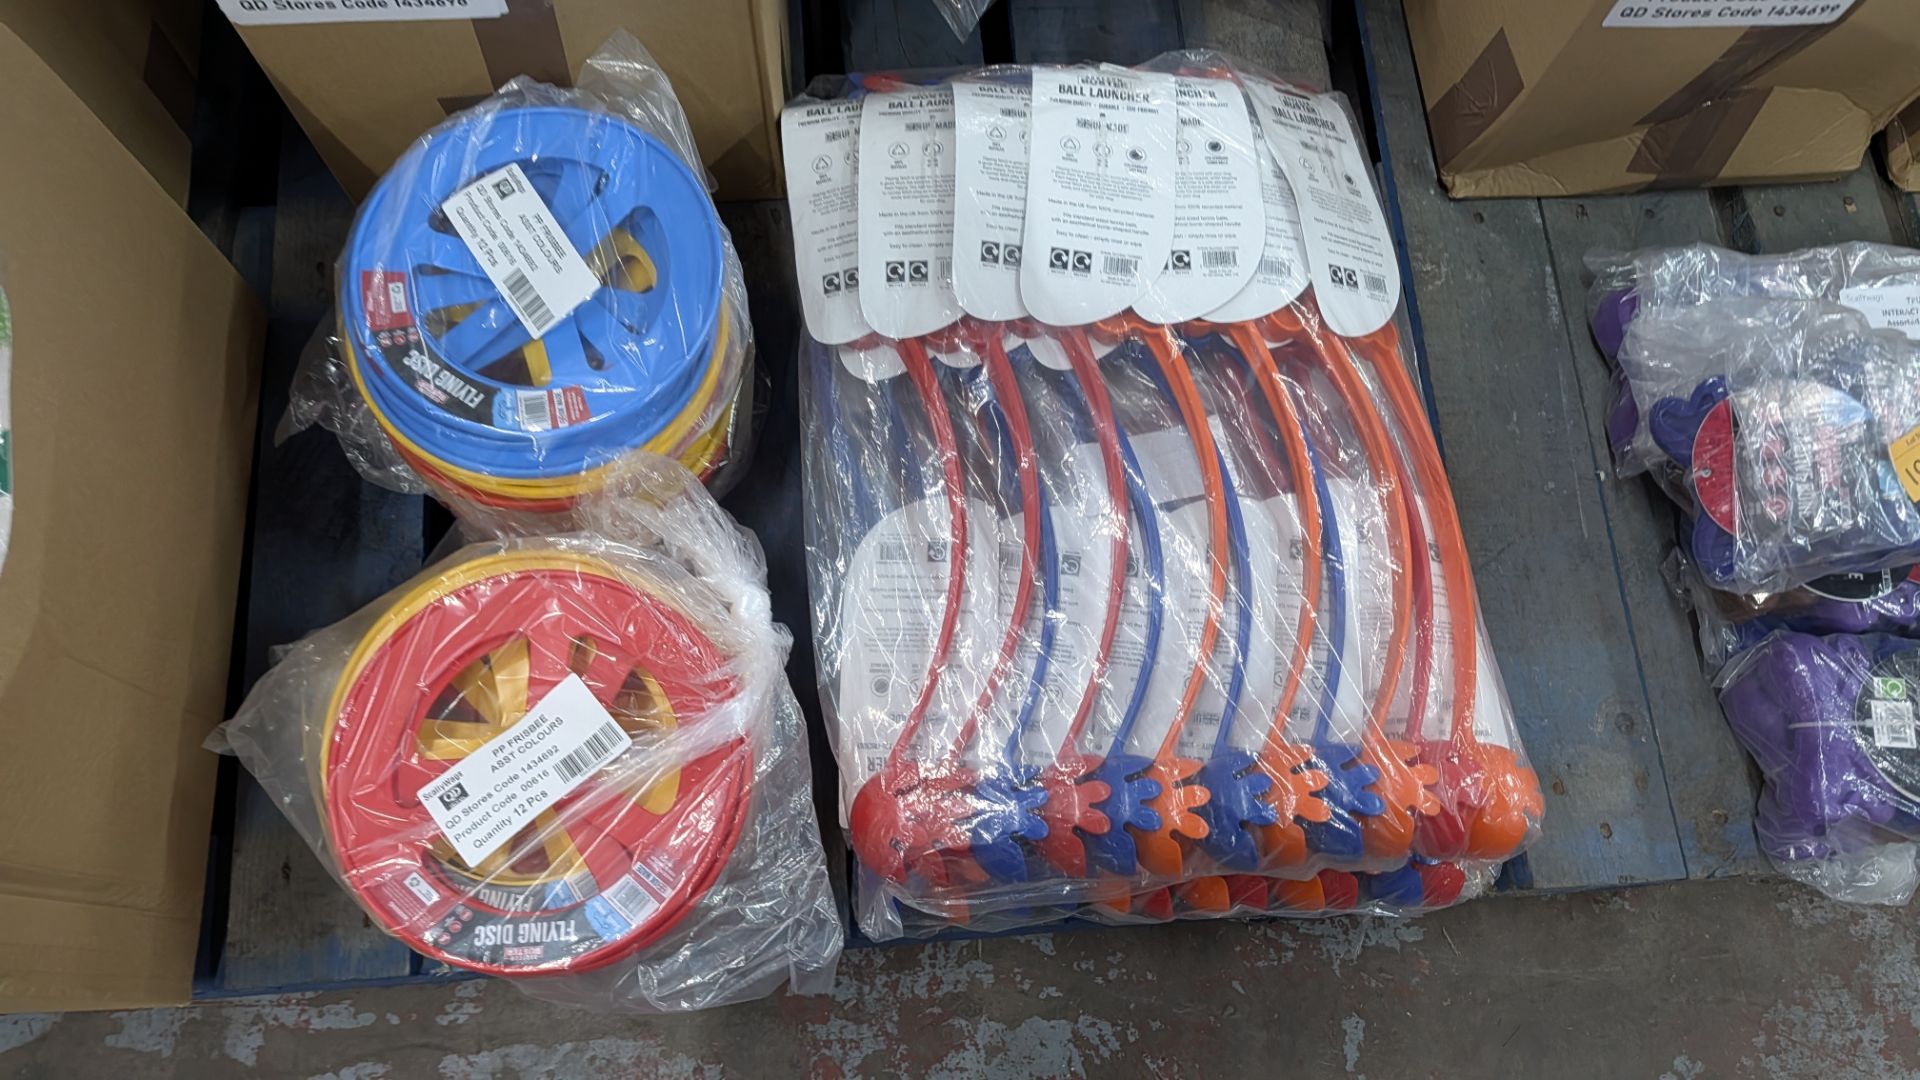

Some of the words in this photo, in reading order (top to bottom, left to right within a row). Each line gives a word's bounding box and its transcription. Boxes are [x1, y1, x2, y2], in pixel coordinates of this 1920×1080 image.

[1620, 7, 1648, 18] QD
[1652, 7, 1712, 18] Stores
[1718, 6, 1762, 17] Code
[1058, 84, 1086, 96] BALL
[1089, 86, 1150, 103] LAUNCHER
[807, 107, 832, 116] BALL
[1272, 105, 1294, 121] BALL
[1294, 113, 1338, 133] LAUNCHER
[434, 369, 486, 409] FLYING
[490, 751, 518, 774] ASST
[518, 716, 564, 755] COLOURS
[491, 745, 507, 758] PP
[508, 714, 549, 749] FRISBEE
[445, 814, 463, 830] QD
[463, 791, 494, 817] Stores
[494, 773, 520, 793] Code
[520, 745, 560, 775] 1434692
[453, 809, 493, 843] Product
[493, 792, 518, 814] Code
[472, 817, 514, 849] Quantity
[513, 806, 528, 817] 12
[528, 790, 549, 808] Pcs
[474, 924, 516, 946] DISC
[518, 920, 578, 944] FLYING
